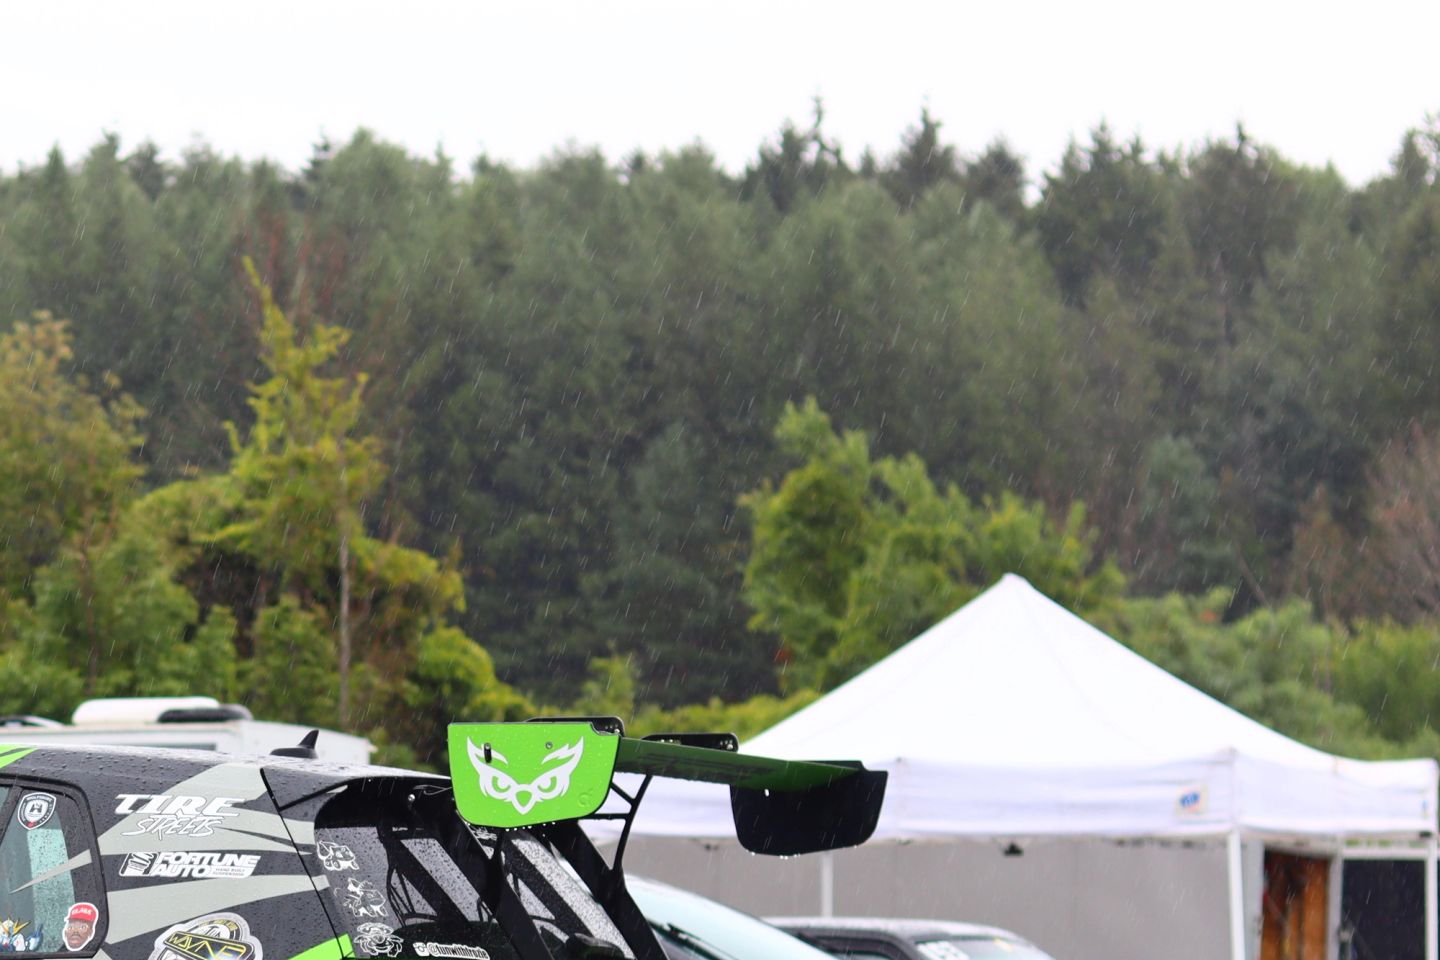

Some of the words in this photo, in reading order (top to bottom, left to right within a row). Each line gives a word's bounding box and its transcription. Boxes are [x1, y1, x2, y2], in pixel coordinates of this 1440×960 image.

[114, 794, 246, 817] TIRE
[121, 814, 225, 841] STREETS
[157, 852, 261, 867] FORTUNE
[151, 865, 211, 878] AUTO
